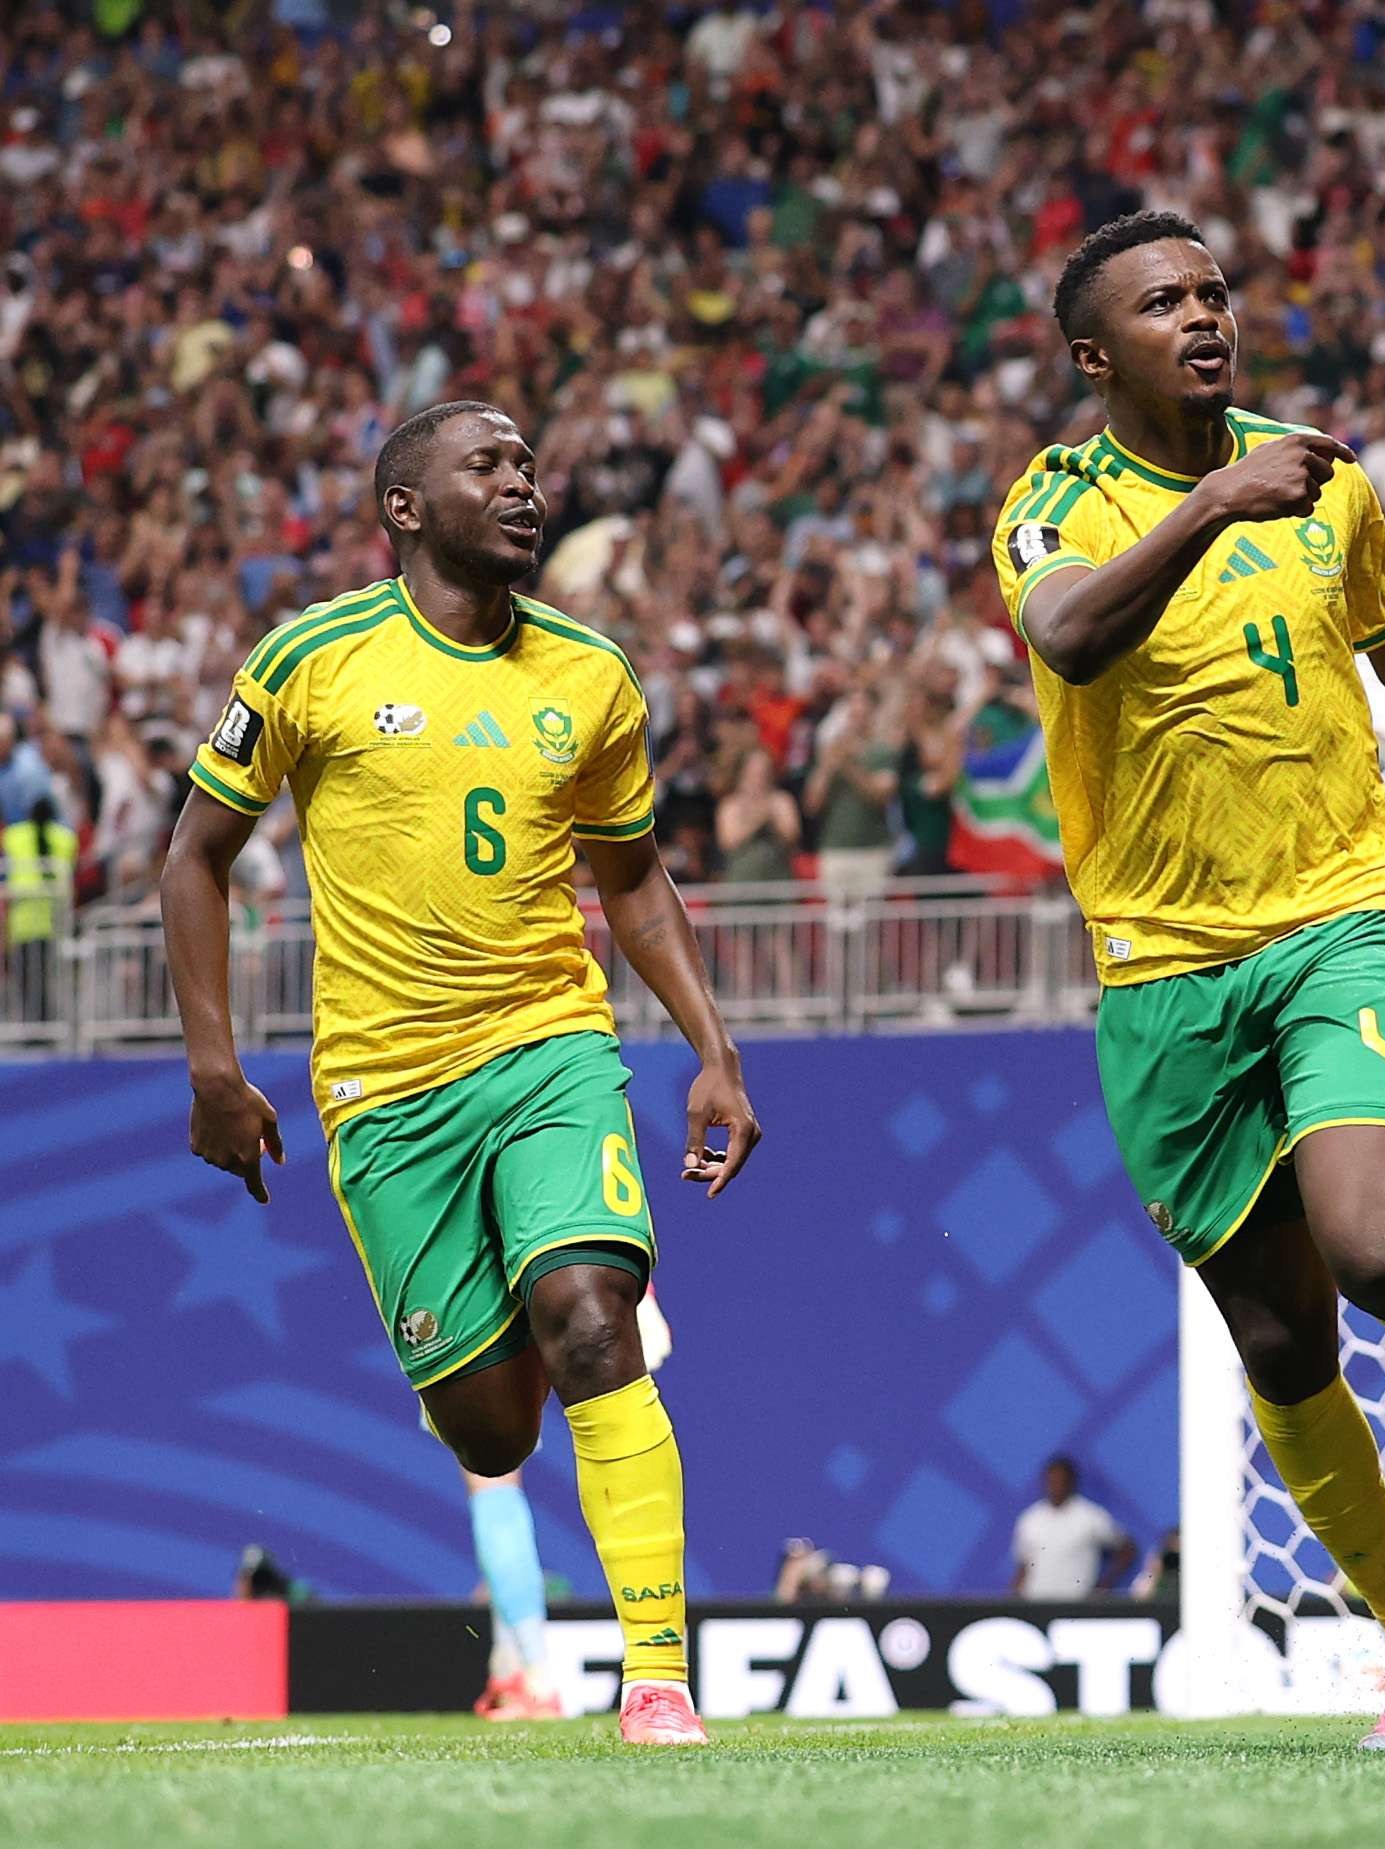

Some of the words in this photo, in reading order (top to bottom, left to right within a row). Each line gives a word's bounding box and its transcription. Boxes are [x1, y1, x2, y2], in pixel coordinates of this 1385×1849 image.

[1244, 615, 1299, 706] 4
[465, 788, 506, 875] 6
[601, 1133, 643, 1217] 6
[621, 1582, 683, 1602] SAFA
[540, 1617, 897, 1718] FFA
